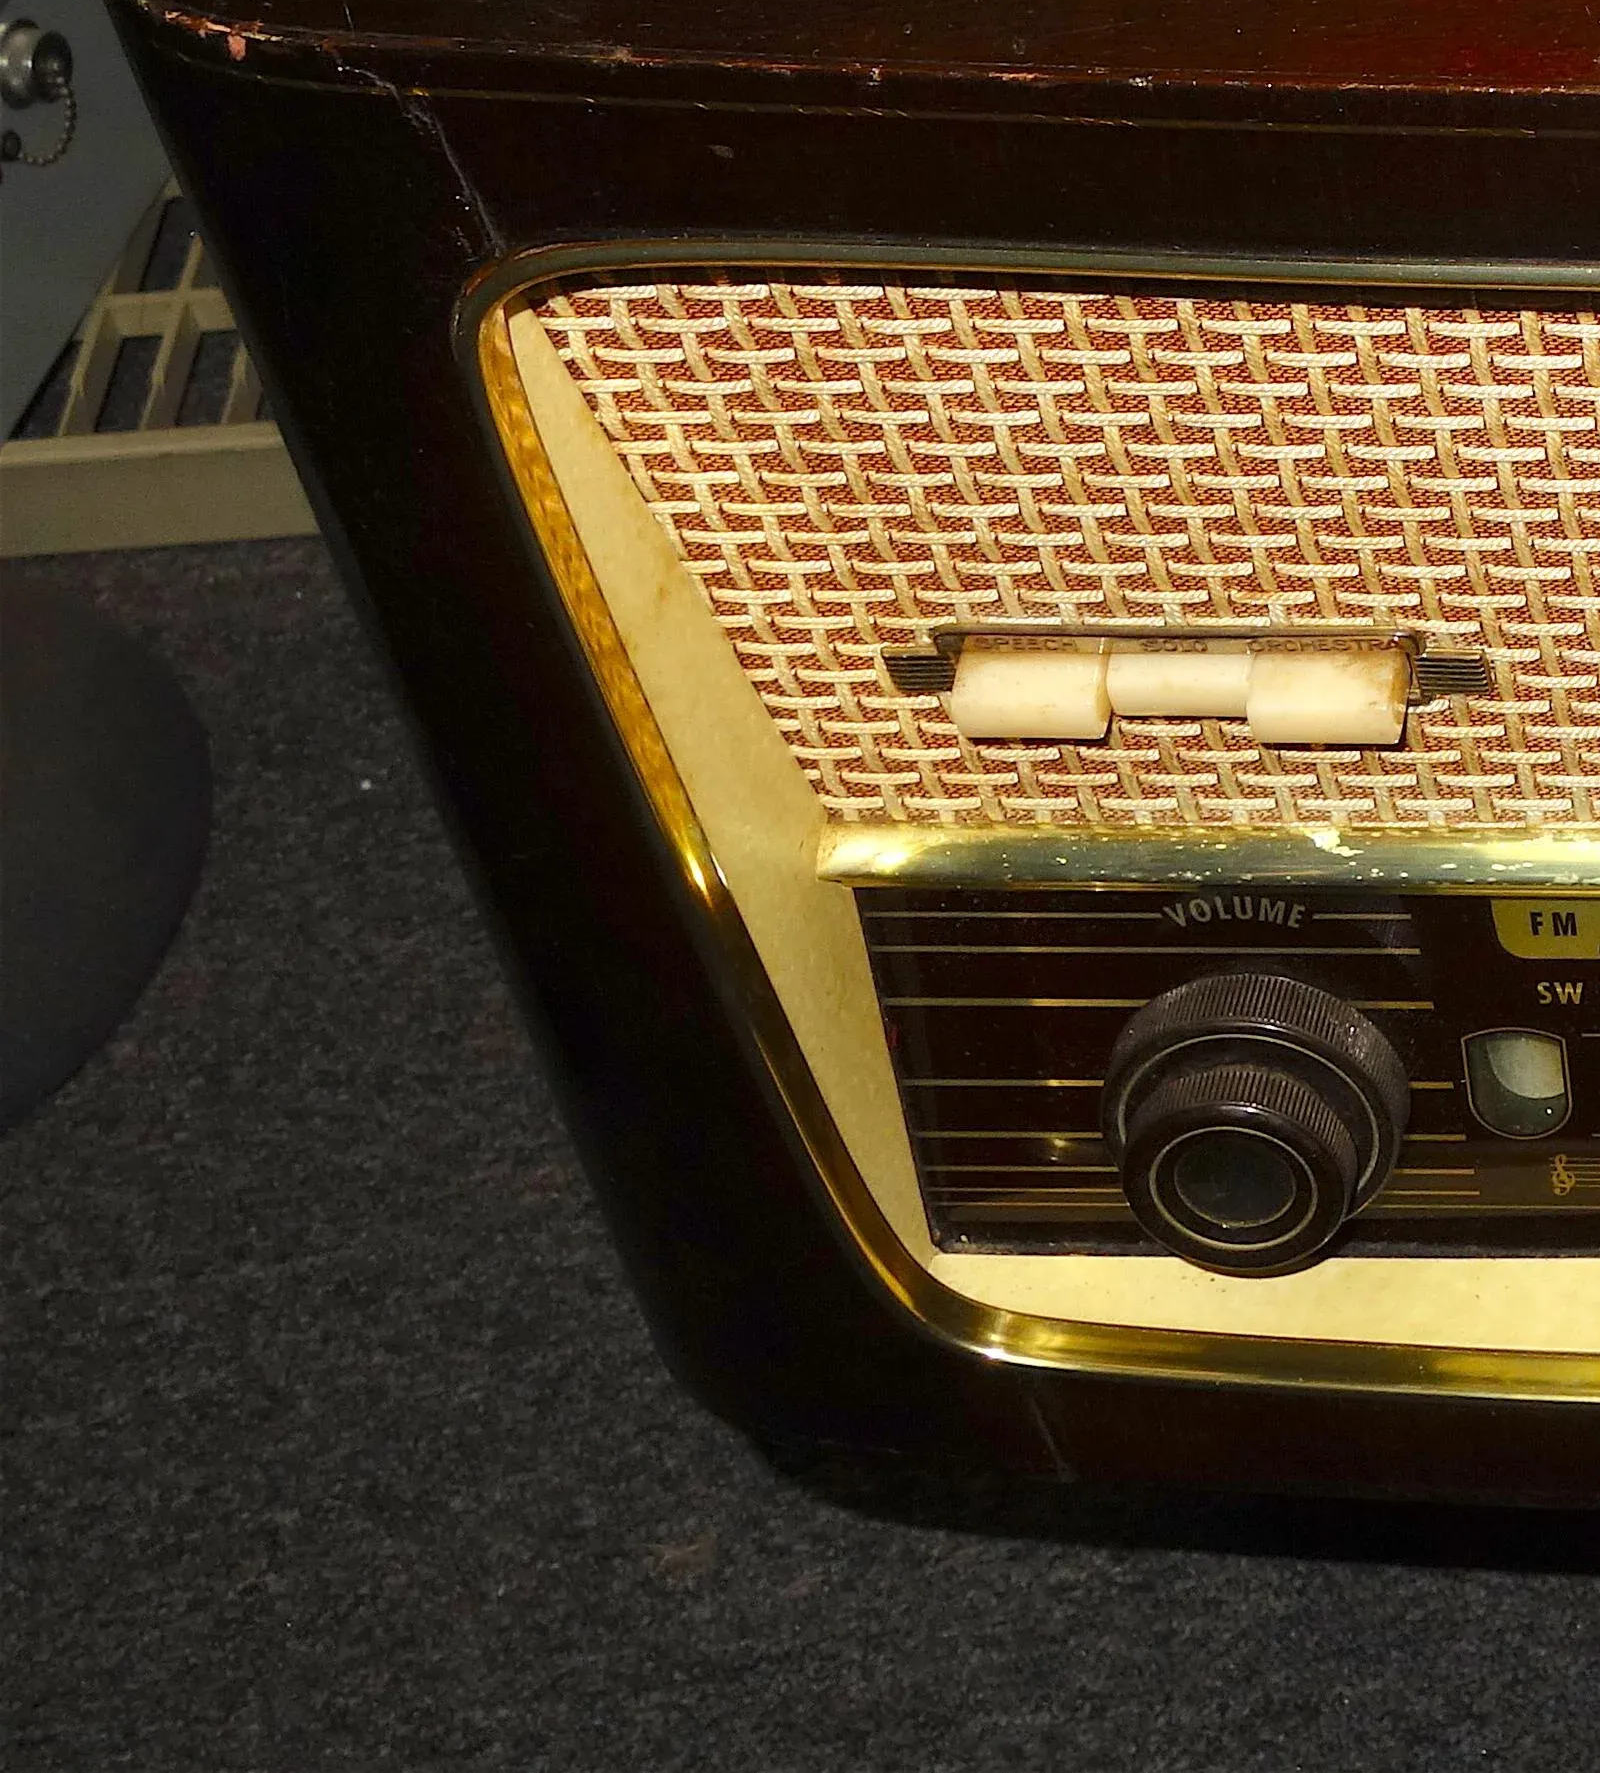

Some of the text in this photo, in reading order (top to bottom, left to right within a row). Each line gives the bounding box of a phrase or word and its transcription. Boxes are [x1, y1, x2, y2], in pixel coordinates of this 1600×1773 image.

[1162, 895, 1307, 928] VOLUME
[1530, 911, 1578, 936] FM
[1537, 981, 1584, 1005] SW
